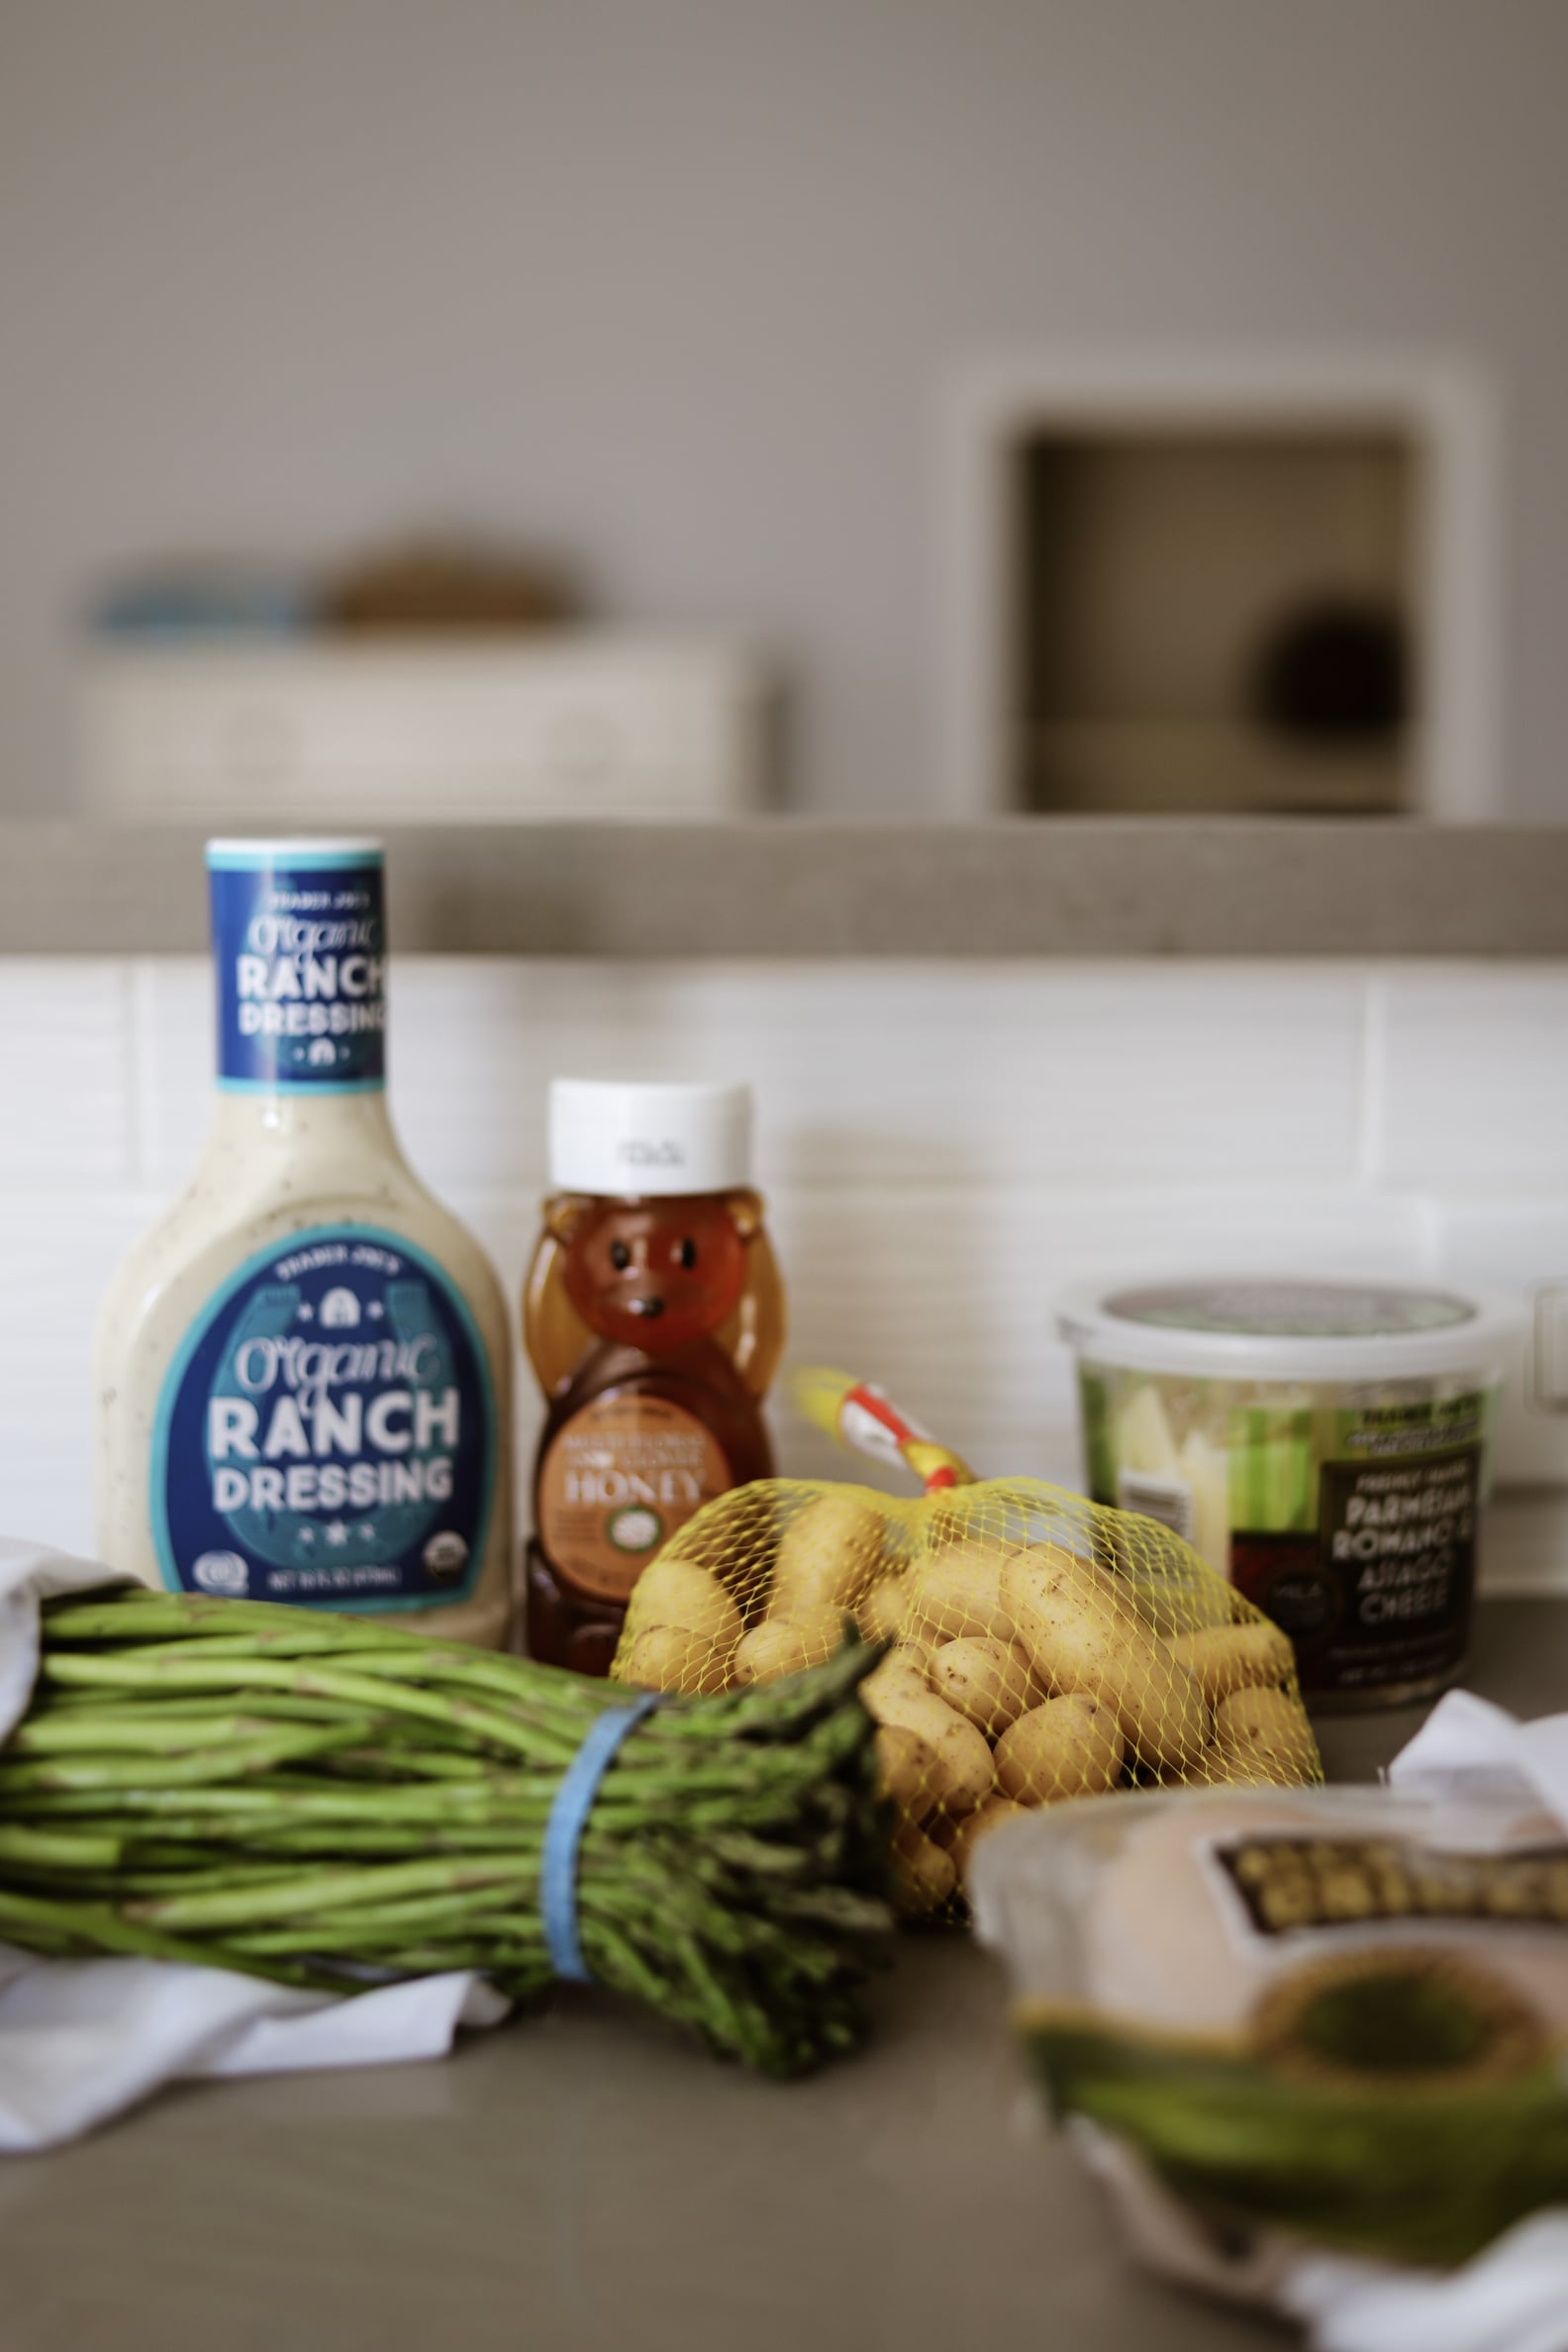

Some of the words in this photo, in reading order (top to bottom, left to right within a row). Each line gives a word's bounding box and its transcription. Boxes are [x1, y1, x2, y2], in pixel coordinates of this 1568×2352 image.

[235, 1332, 441, 1419] Organic
[208, 1387, 461, 1460] RANCH
[212, 1455, 454, 1514] DRESSING
[563, 1469, 708, 1506] HONEY
[1330, 1516, 1455, 1562] ROMANO
